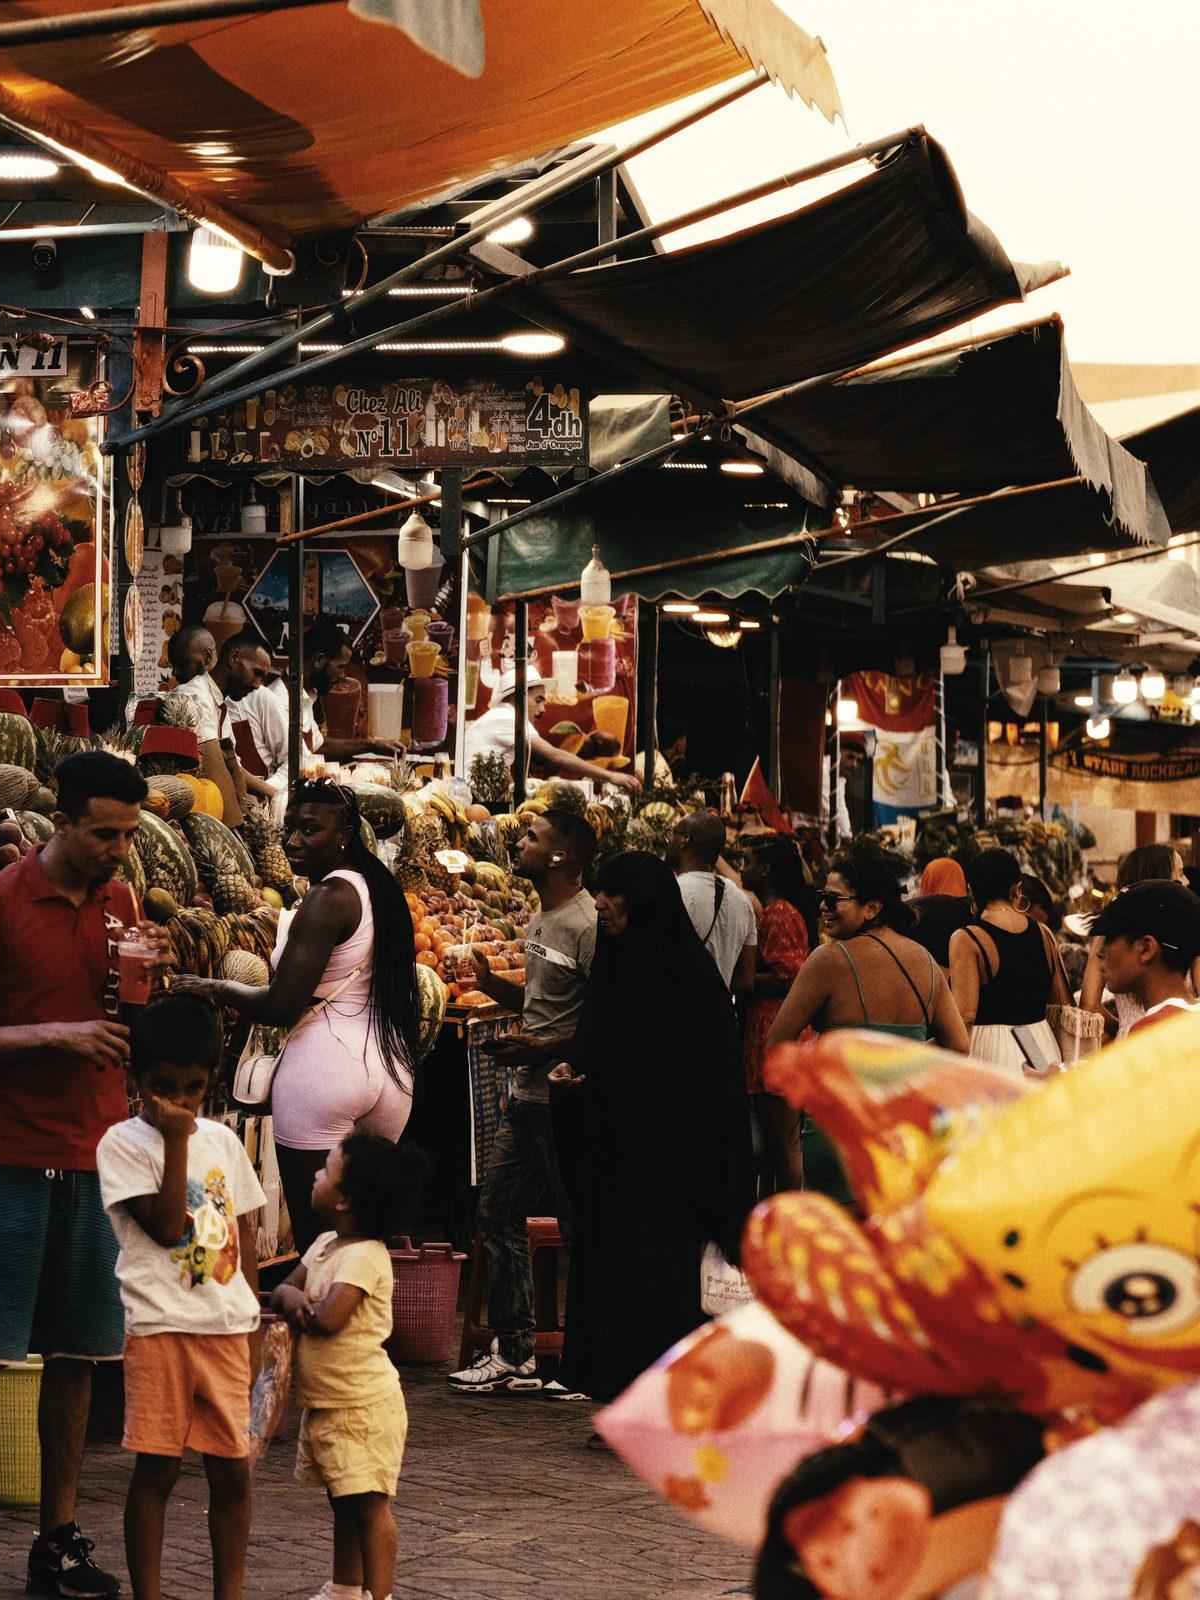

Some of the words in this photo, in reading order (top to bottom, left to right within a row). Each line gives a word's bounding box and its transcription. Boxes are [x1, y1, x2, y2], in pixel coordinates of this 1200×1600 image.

[345, 388, 388, 414] Chez
[393, 388, 423, 414] Ali
[527, 440, 541, 451] Jus
